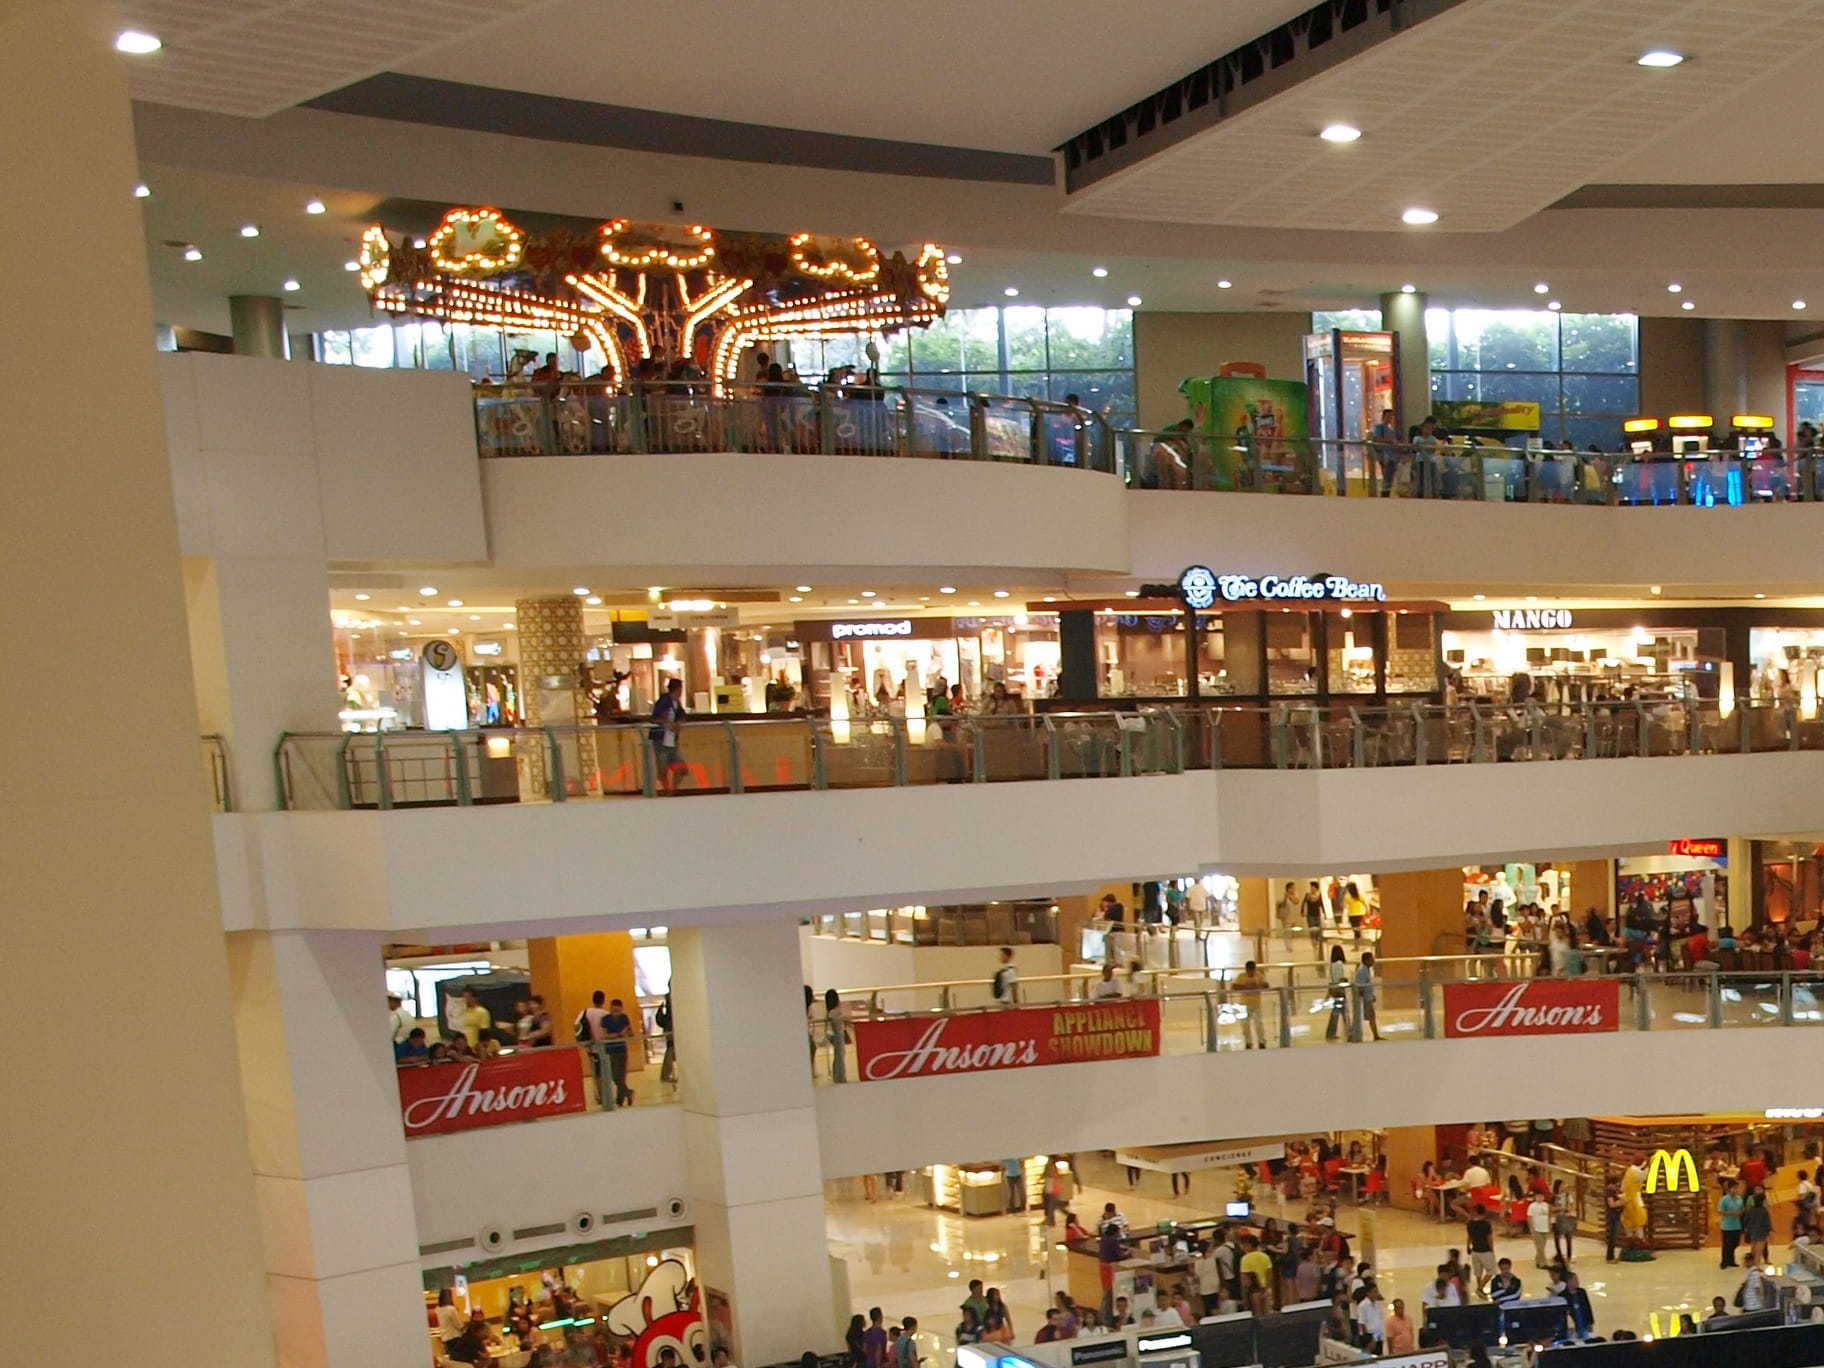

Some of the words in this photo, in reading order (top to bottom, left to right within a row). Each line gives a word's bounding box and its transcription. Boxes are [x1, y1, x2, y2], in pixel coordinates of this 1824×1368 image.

[1218, 575, 1258, 600] The
[1260, 576, 1324, 598] Coffee
[1326, 576, 1386, 601] Bean
[831, 620, 912, 639] promod
[1493, 609, 1573, 629] MANGO
[1680, 837, 1718, 854] Queen
[1052, 1003, 1147, 1034] APPLIANCE
[1455, 983, 1604, 1034] Anson's
[866, 1018, 1039, 1080] Anson's
[1047, 1029, 1153, 1058] SHOWDOWN
[405, 1063, 567, 1129] Anson's
